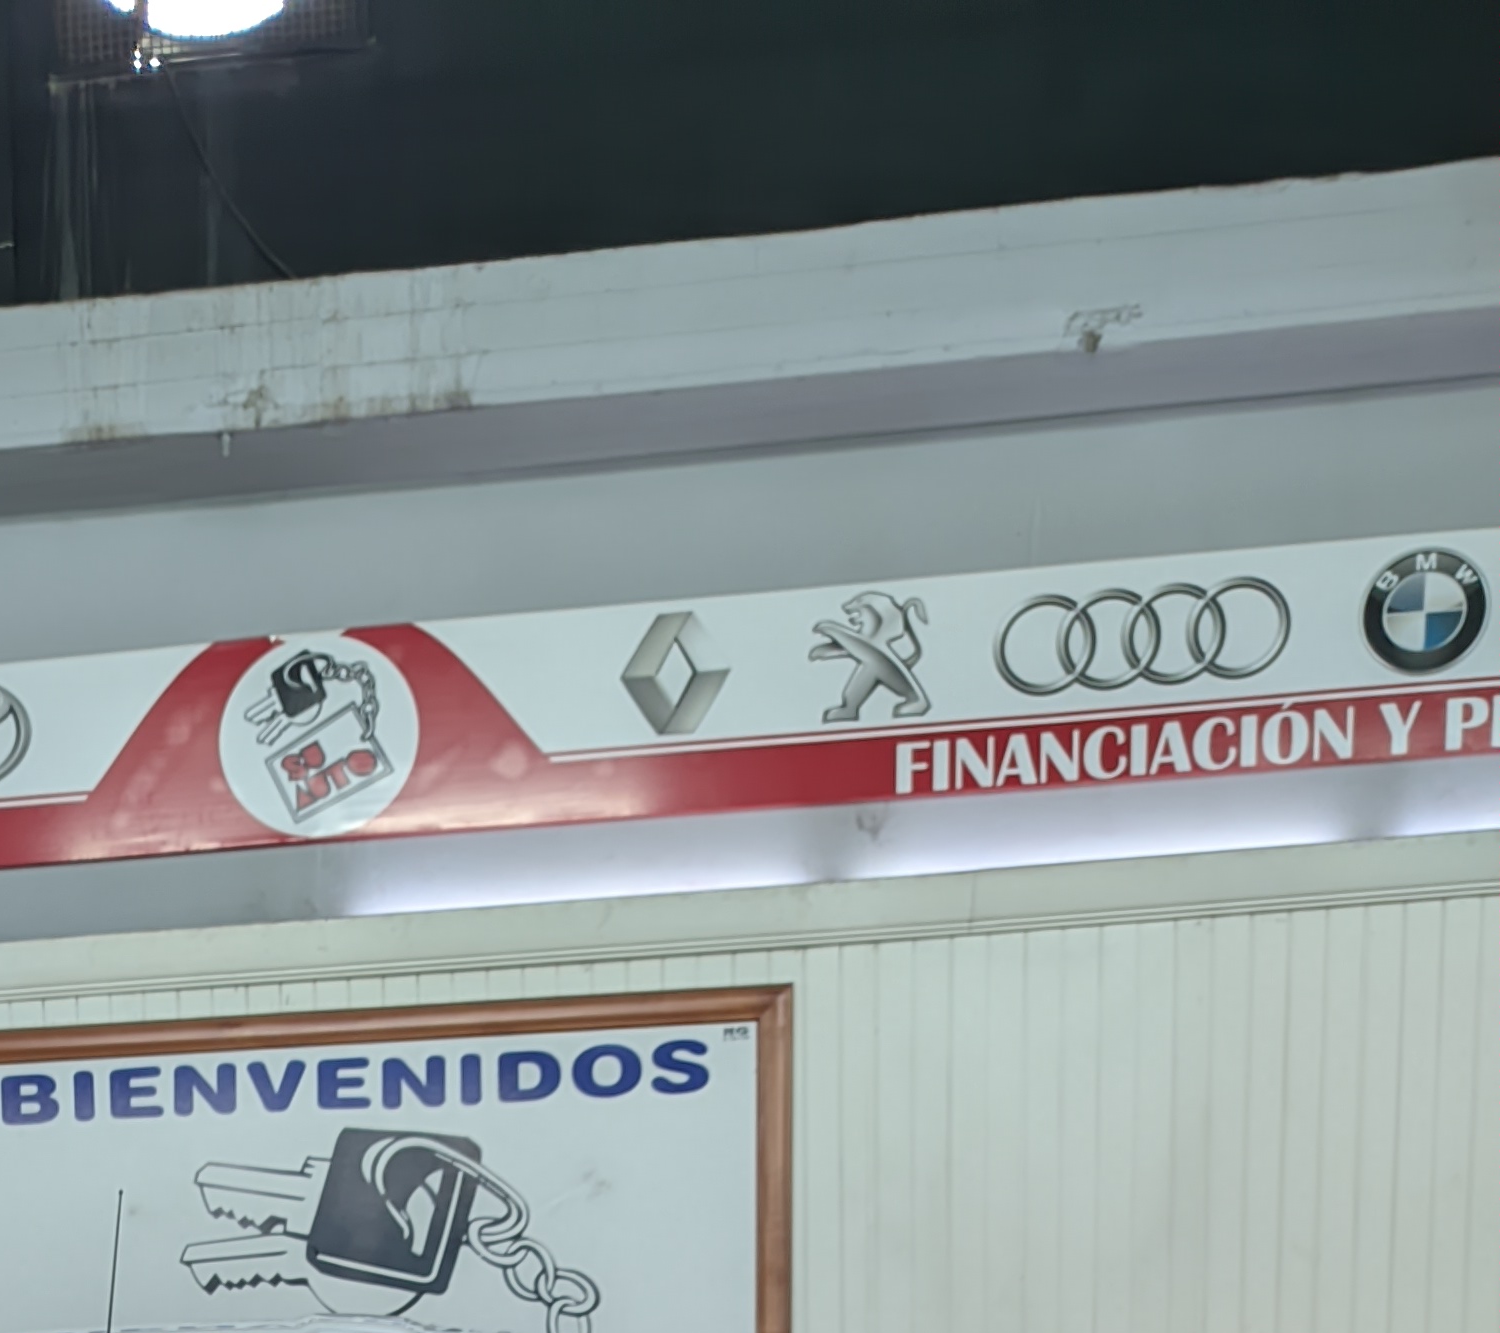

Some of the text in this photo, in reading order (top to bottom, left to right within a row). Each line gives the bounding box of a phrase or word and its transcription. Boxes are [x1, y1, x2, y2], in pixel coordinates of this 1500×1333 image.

[1376, 552, 1478, 591] BMW
[280, 740, 325, 781] SU
[894, 694, 1500, 795] FINANCIACIÓN Y P
[296, 749, 377, 812] AUTO
[0, 1039, 711, 1126] BIENVENIDOS
